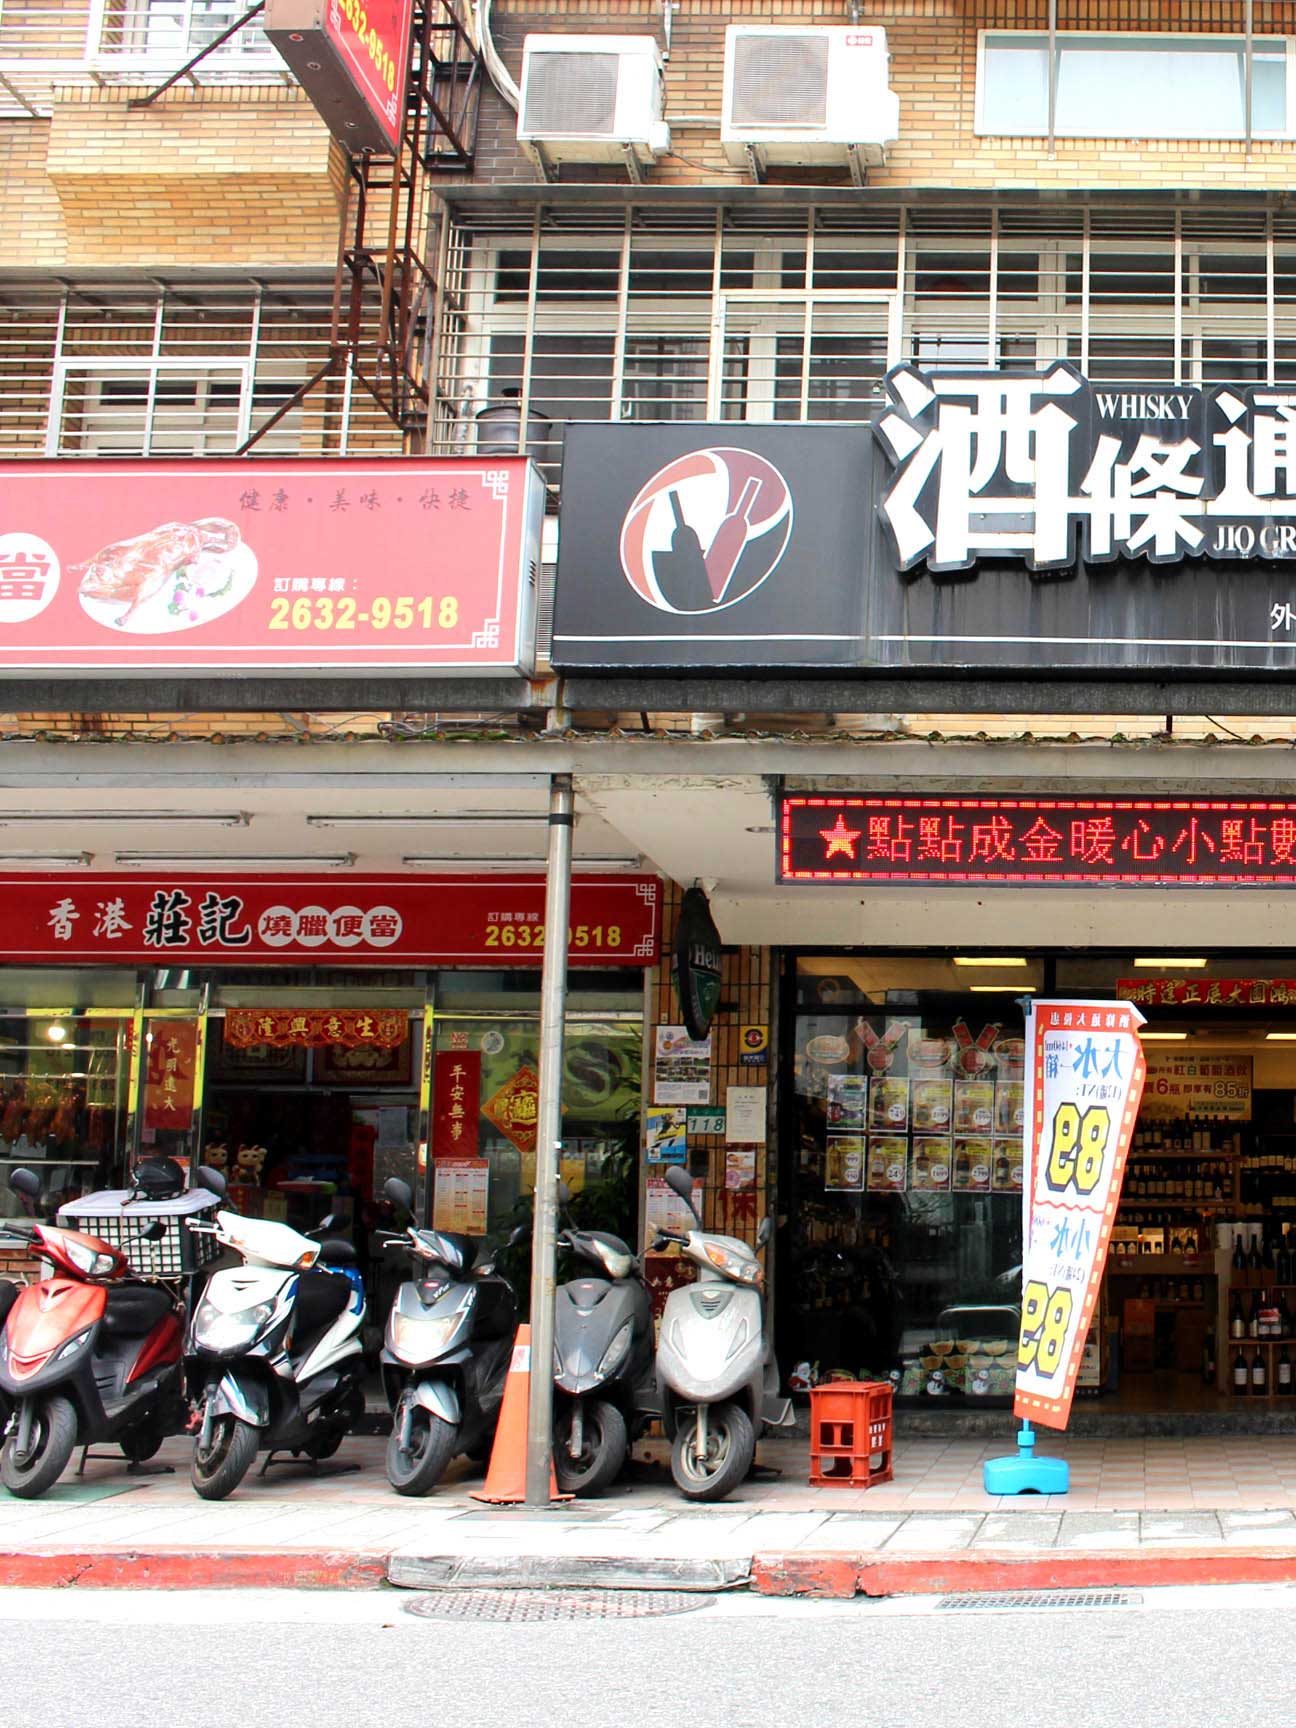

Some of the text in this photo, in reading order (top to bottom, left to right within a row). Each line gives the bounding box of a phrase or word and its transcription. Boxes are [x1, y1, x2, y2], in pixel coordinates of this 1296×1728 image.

[1096, 393, 1193, 420] WHISKY
[1213, 525, 1255, 552] JIO
[268, 596, 459, 630] 2632-9518
[48, 897, 133, 941] 香港
[688, 1118, 724, 1132] 118
